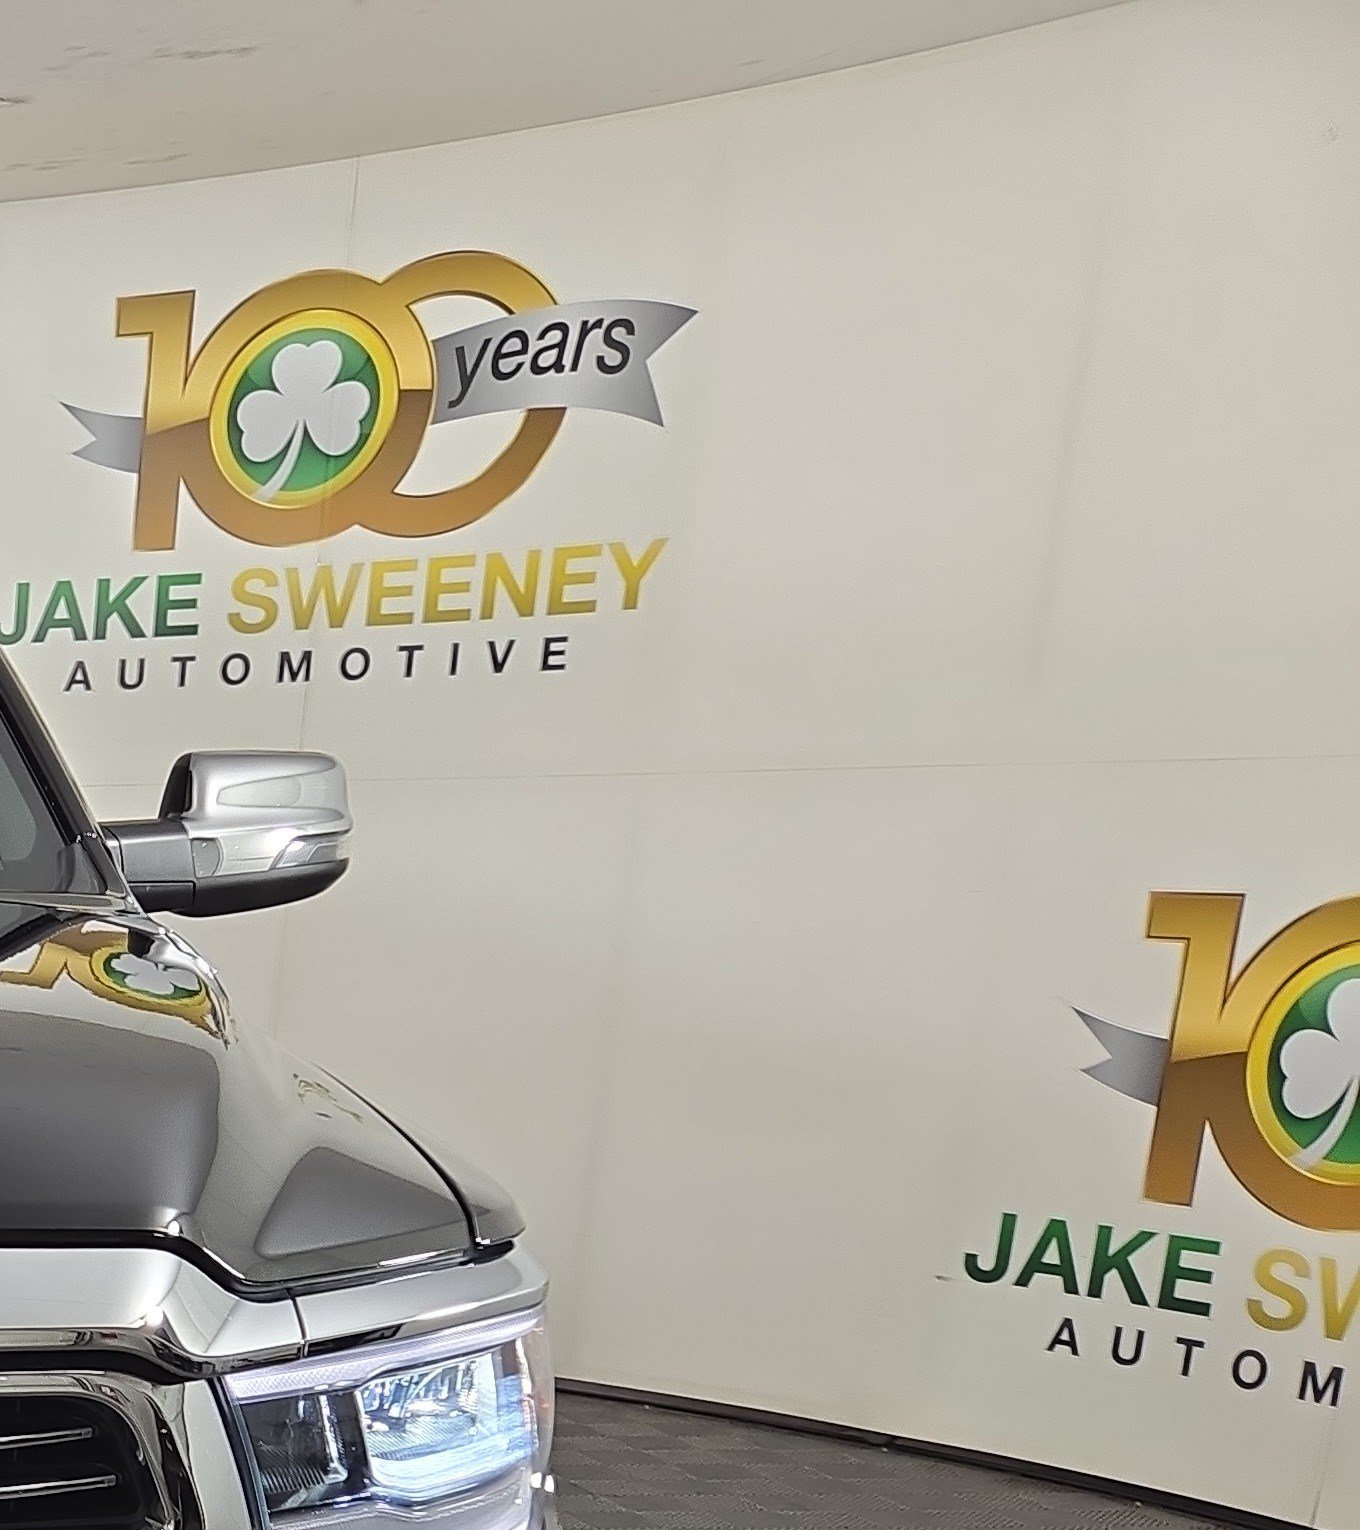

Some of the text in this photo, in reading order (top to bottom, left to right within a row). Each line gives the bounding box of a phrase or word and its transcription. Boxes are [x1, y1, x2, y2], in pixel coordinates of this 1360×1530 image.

[448, 315, 636, 409] years
[226, 537, 669, 635] SWEENEY
[64, 636, 571, 693] AUTOMOTIVE
[963, 1211, 1222, 1318] JAKE
